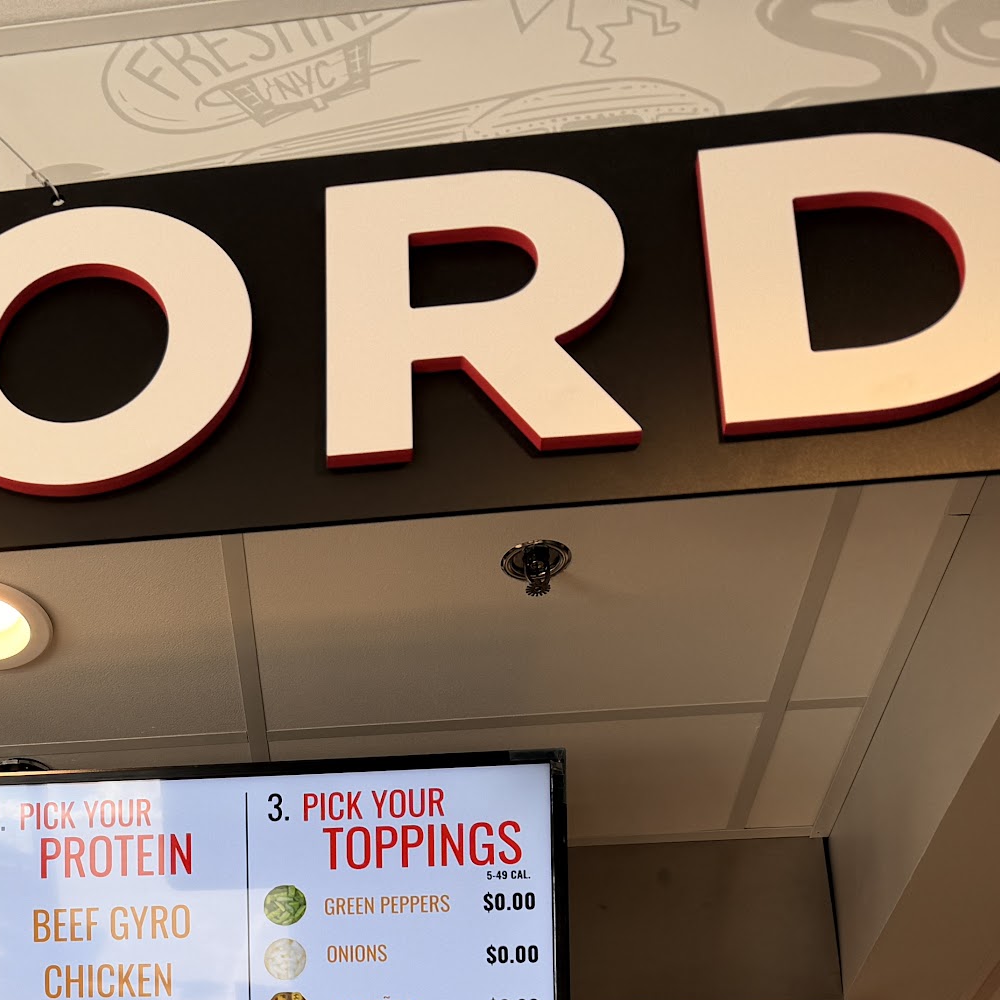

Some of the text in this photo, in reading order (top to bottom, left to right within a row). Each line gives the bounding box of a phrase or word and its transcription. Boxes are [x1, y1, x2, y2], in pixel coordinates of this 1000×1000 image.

[273, 60, 337, 101] NYC
[19, 800, 76, 831] PICK
[83, 798, 152, 829] YOUR
[267, 787, 445, 822] 3. PICK YOUR
[40, 832, 193, 879] PROTEIN
[322, 820, 522, 870] TOPPINGS
[486, 870, 531, 881] 5-49 CAL.
[324, 892, 536, 916] GREEN PEPPERS $0.00
[33, 904, 191, 943] BEEF GYRO
[327, 944, 539, 966] ONIONS $0.00
[44, 962, 173, 999] CHICKEN
